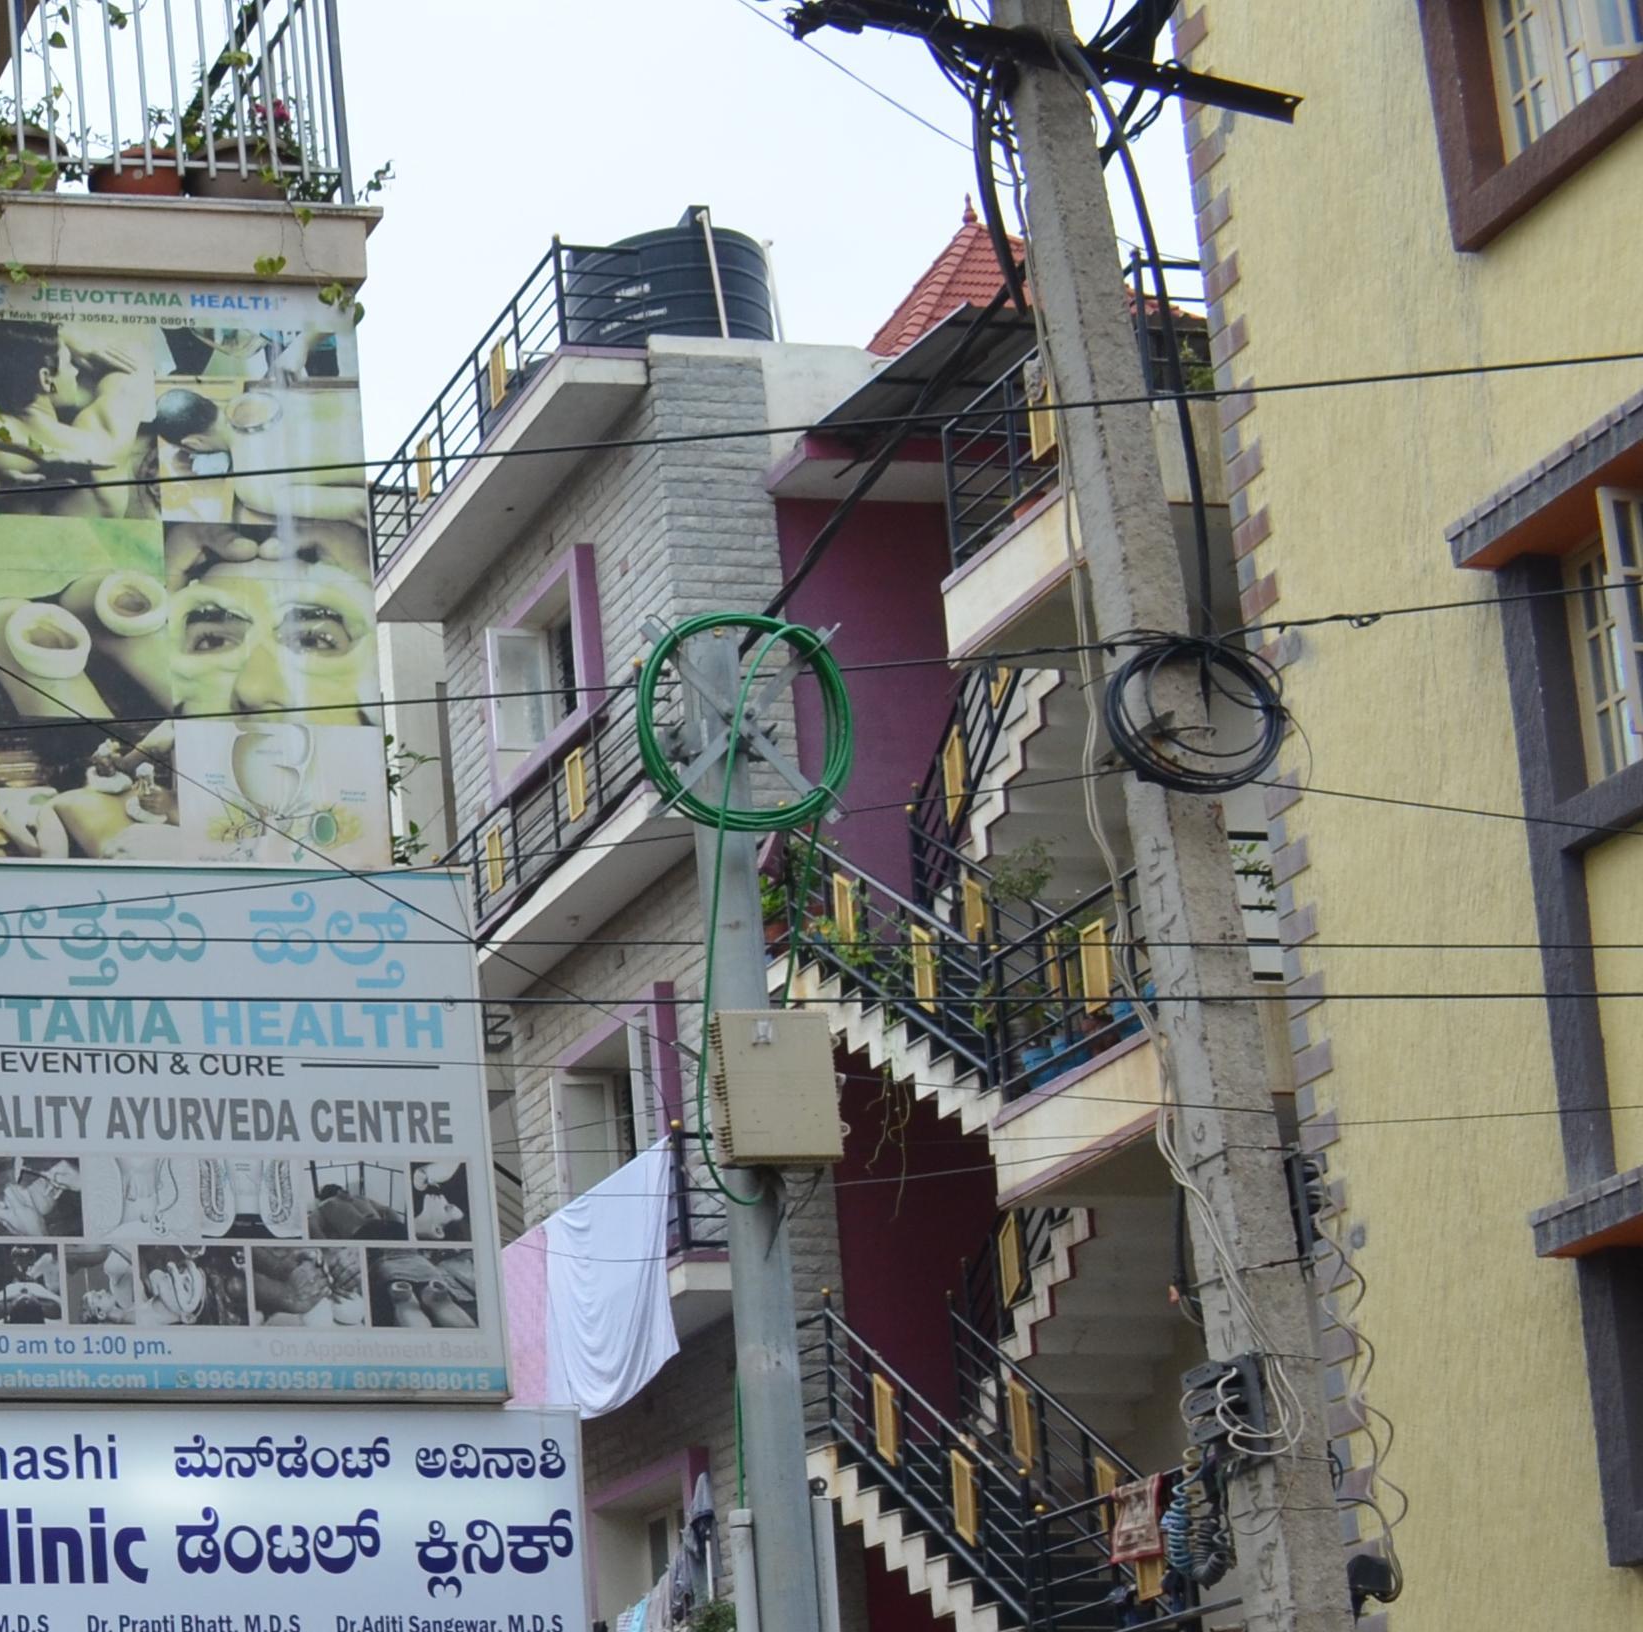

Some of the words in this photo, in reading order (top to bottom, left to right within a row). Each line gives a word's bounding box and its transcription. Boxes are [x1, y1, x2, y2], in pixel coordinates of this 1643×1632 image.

[31, 287, 183, 307] JEEVOTTAMA
[202, 1001, 445, 1049] HEALTH
[199, 1052, 285, 1077] CURE
[109, 1095, 299, 1143] AYURVEDA
[311, 1099, 453, 1144] CENTRE
[84, 1337, 126, 1355] 1:00
[415, 1438, 566, 1479] ಅವಿನಾಶಿ
[176, 1507, 380, 1574] ಡೆಂಟಲ್
[416, 1509, 573, 1598] ಕ್ಲಿನಿಕ್
